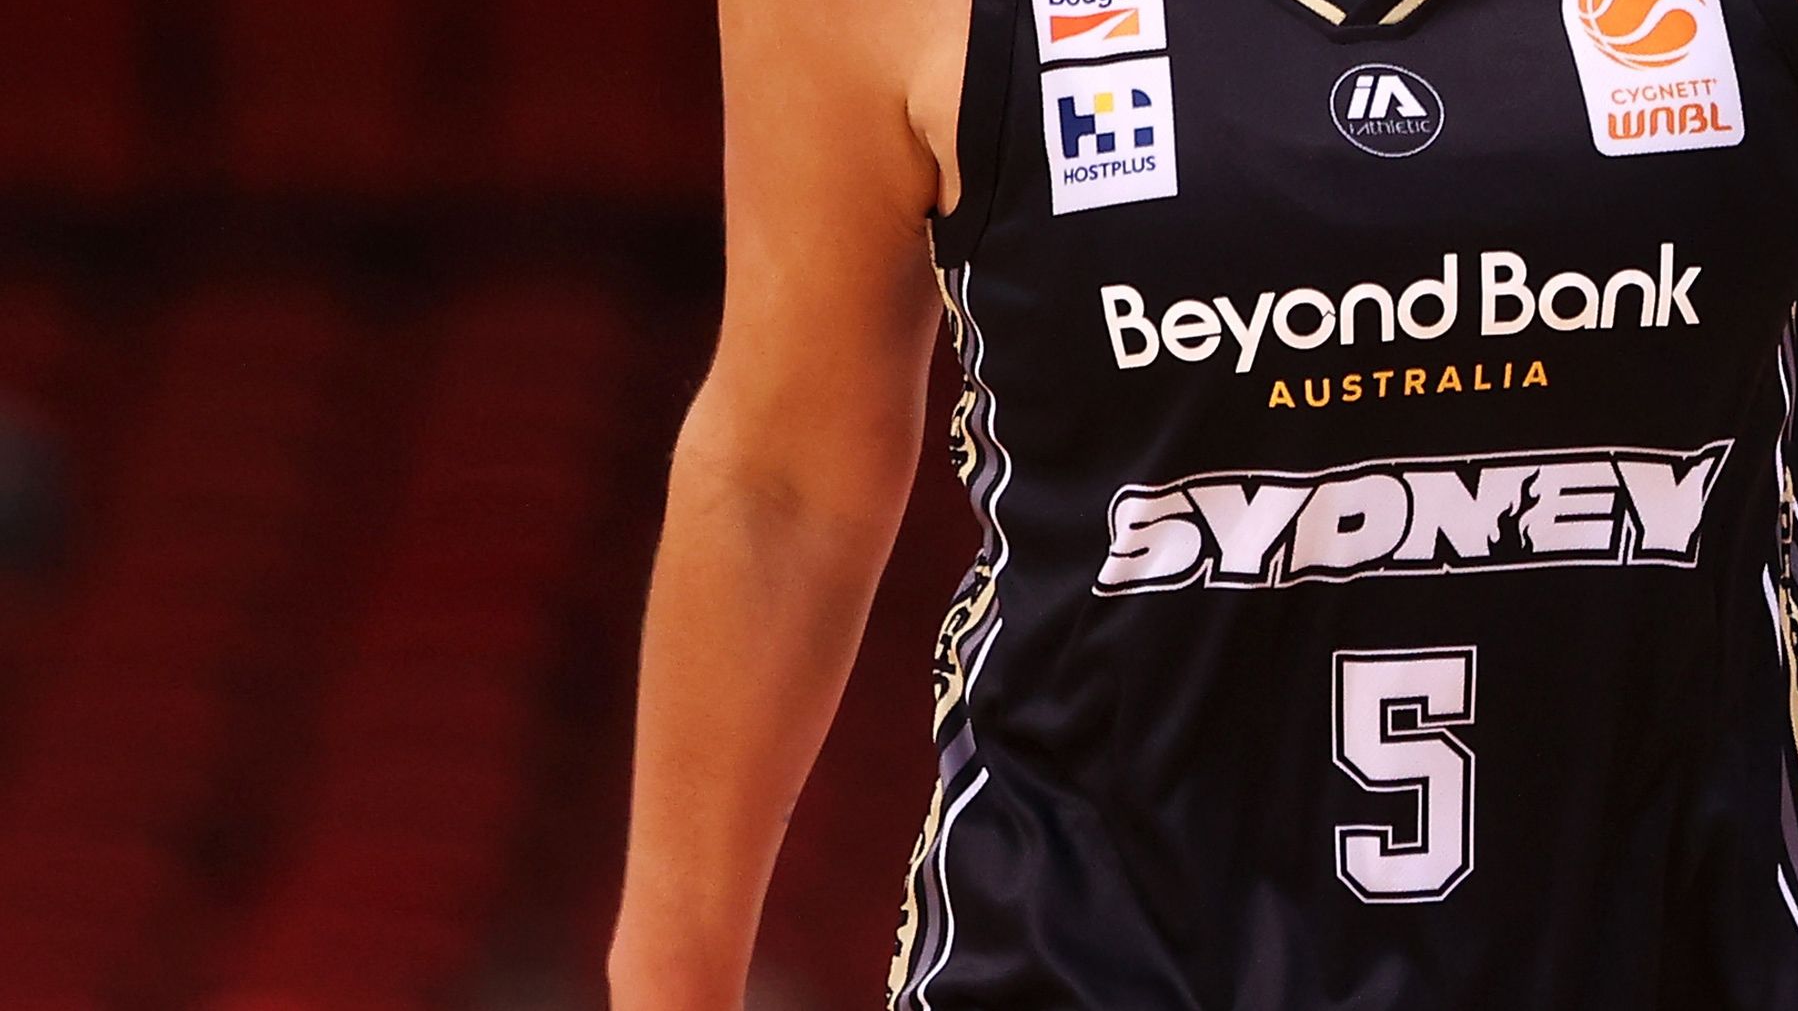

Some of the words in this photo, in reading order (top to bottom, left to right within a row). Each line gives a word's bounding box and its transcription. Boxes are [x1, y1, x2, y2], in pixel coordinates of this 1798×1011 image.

[1611, 79, 1714, 105] CYGNETT
[1607, 102, 1733, 140] WNBL
[1063, 156, 1157, 186] HOSTPLUS
[1101, 253, 1458, 373] Beyond
[1480, 243, 1702, 336] Bank
[1268, 361, 1550, 409] AUSTRALIA
[1092, 439, 1735, 596] SYDNEY
[1332, 645, 1478, 904] 5
